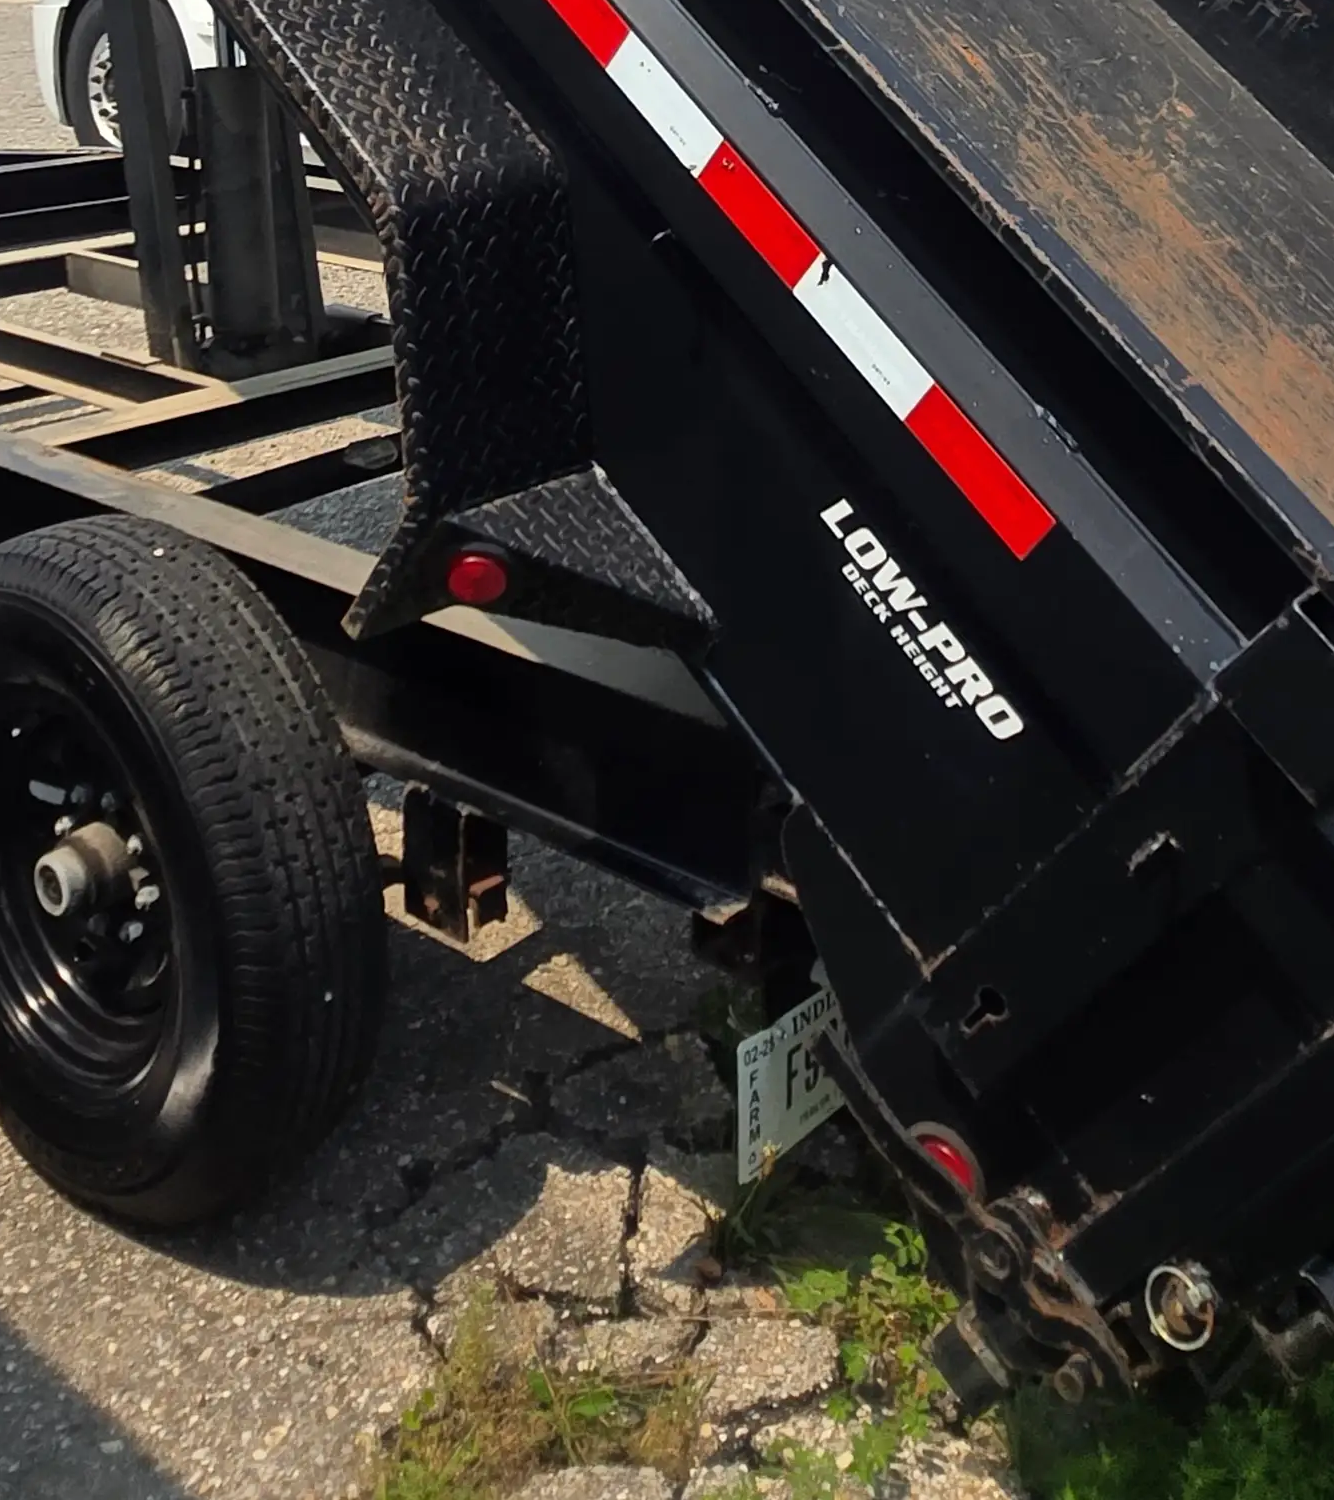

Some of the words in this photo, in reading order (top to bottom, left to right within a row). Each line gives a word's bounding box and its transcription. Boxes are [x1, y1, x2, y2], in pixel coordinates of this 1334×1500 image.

[820, 498, 1024, 740] LOW-PRO
[841, 562, 892, 624] DECK
[890, 623, 963, 708] HEIGHT
[792, 990, 836, 1036] INDI
[748, 1069, 761, 1146] FARM
